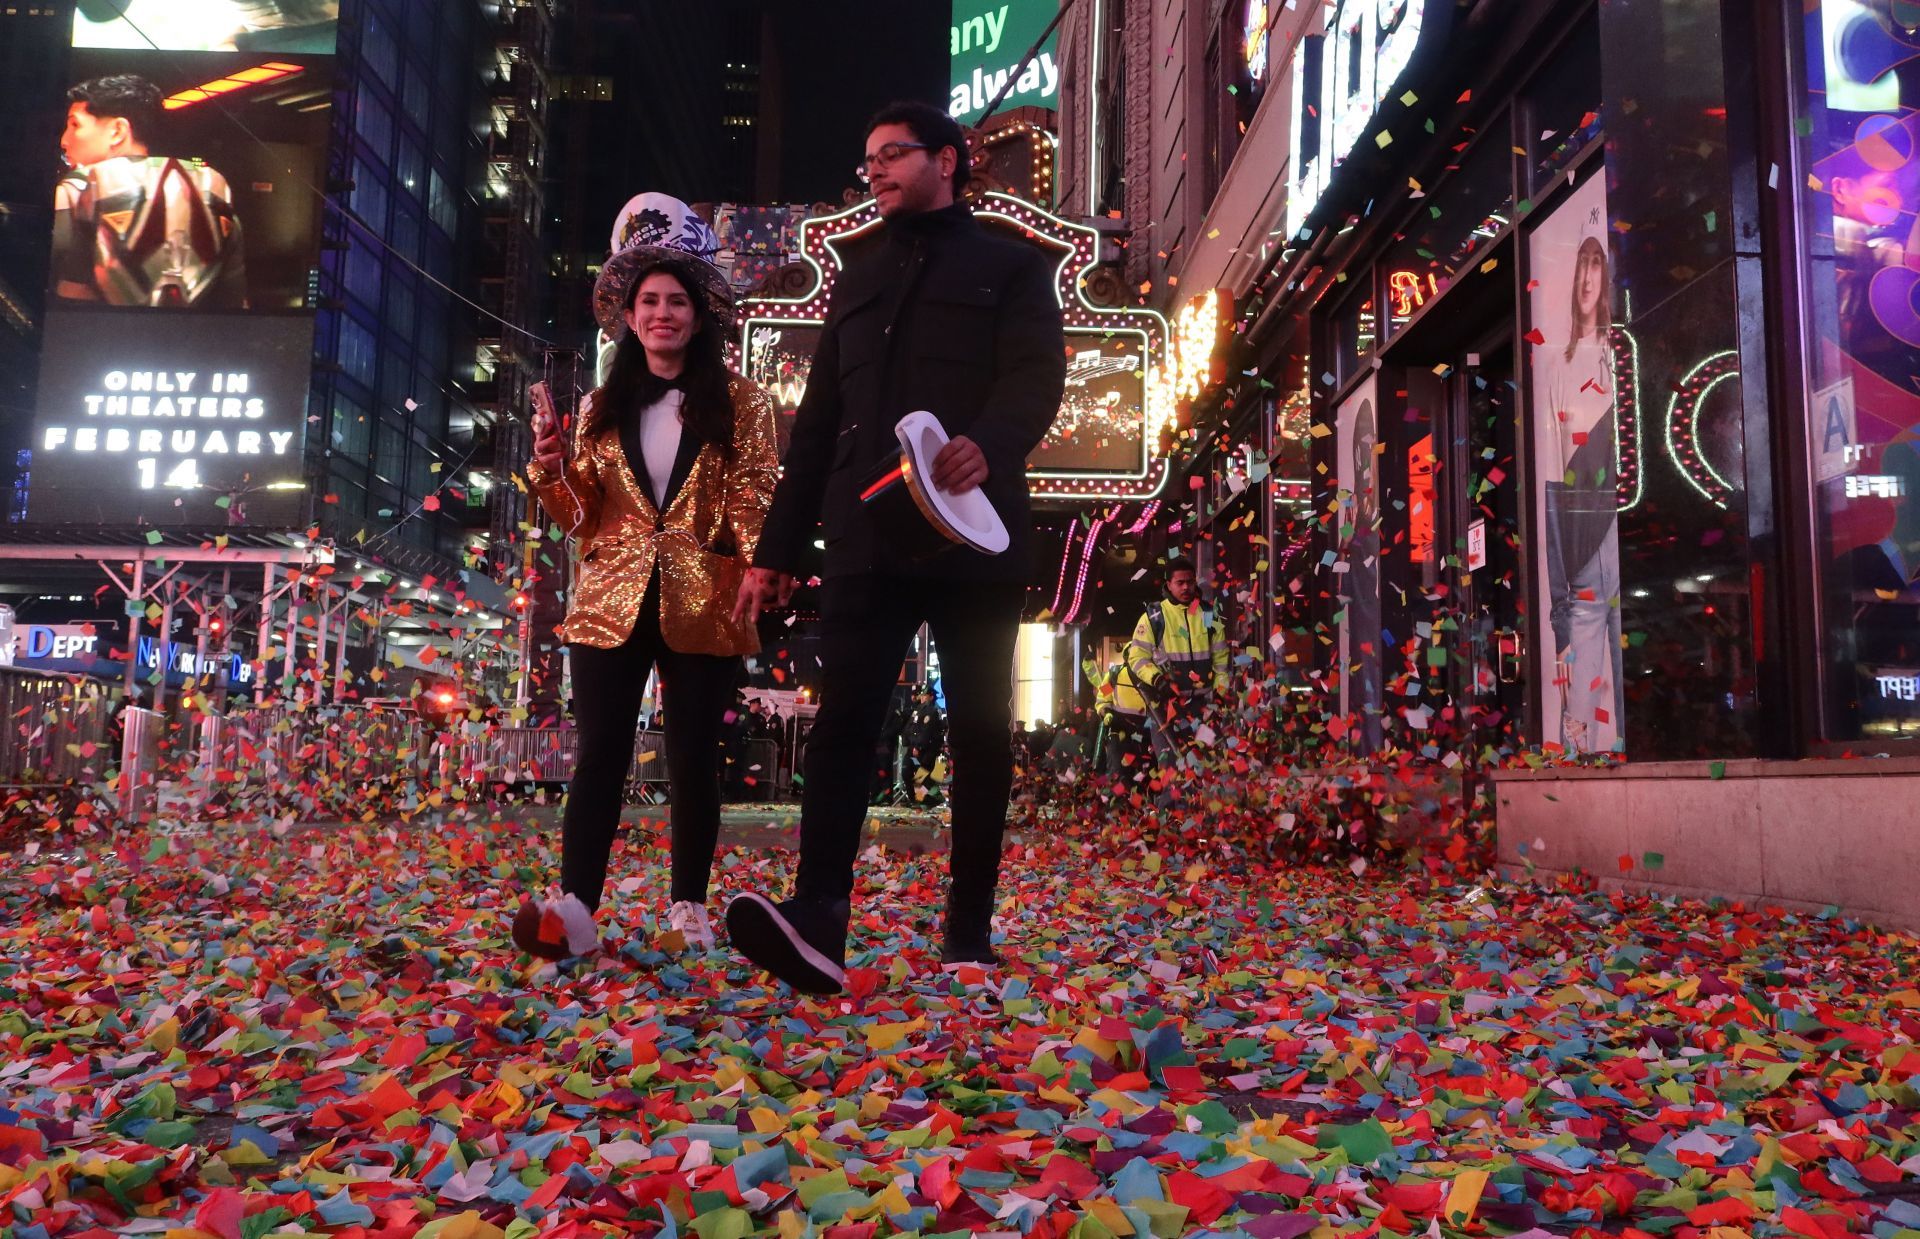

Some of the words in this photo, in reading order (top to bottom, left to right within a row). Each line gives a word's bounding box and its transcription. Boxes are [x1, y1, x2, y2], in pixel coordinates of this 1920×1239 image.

[104, 370, 196, 392] ONLY
[211, 373, 248, 393] IN
[84, 395, 264, 418] THEATERS
[1822, 394, 1850, 455] A
[44, 427, 293, 454] FEBRUARY
[137, 458, 200, 489] 14
[27, 626, 97, 659] DEPT
[232, 654, 252, 682] DEP
